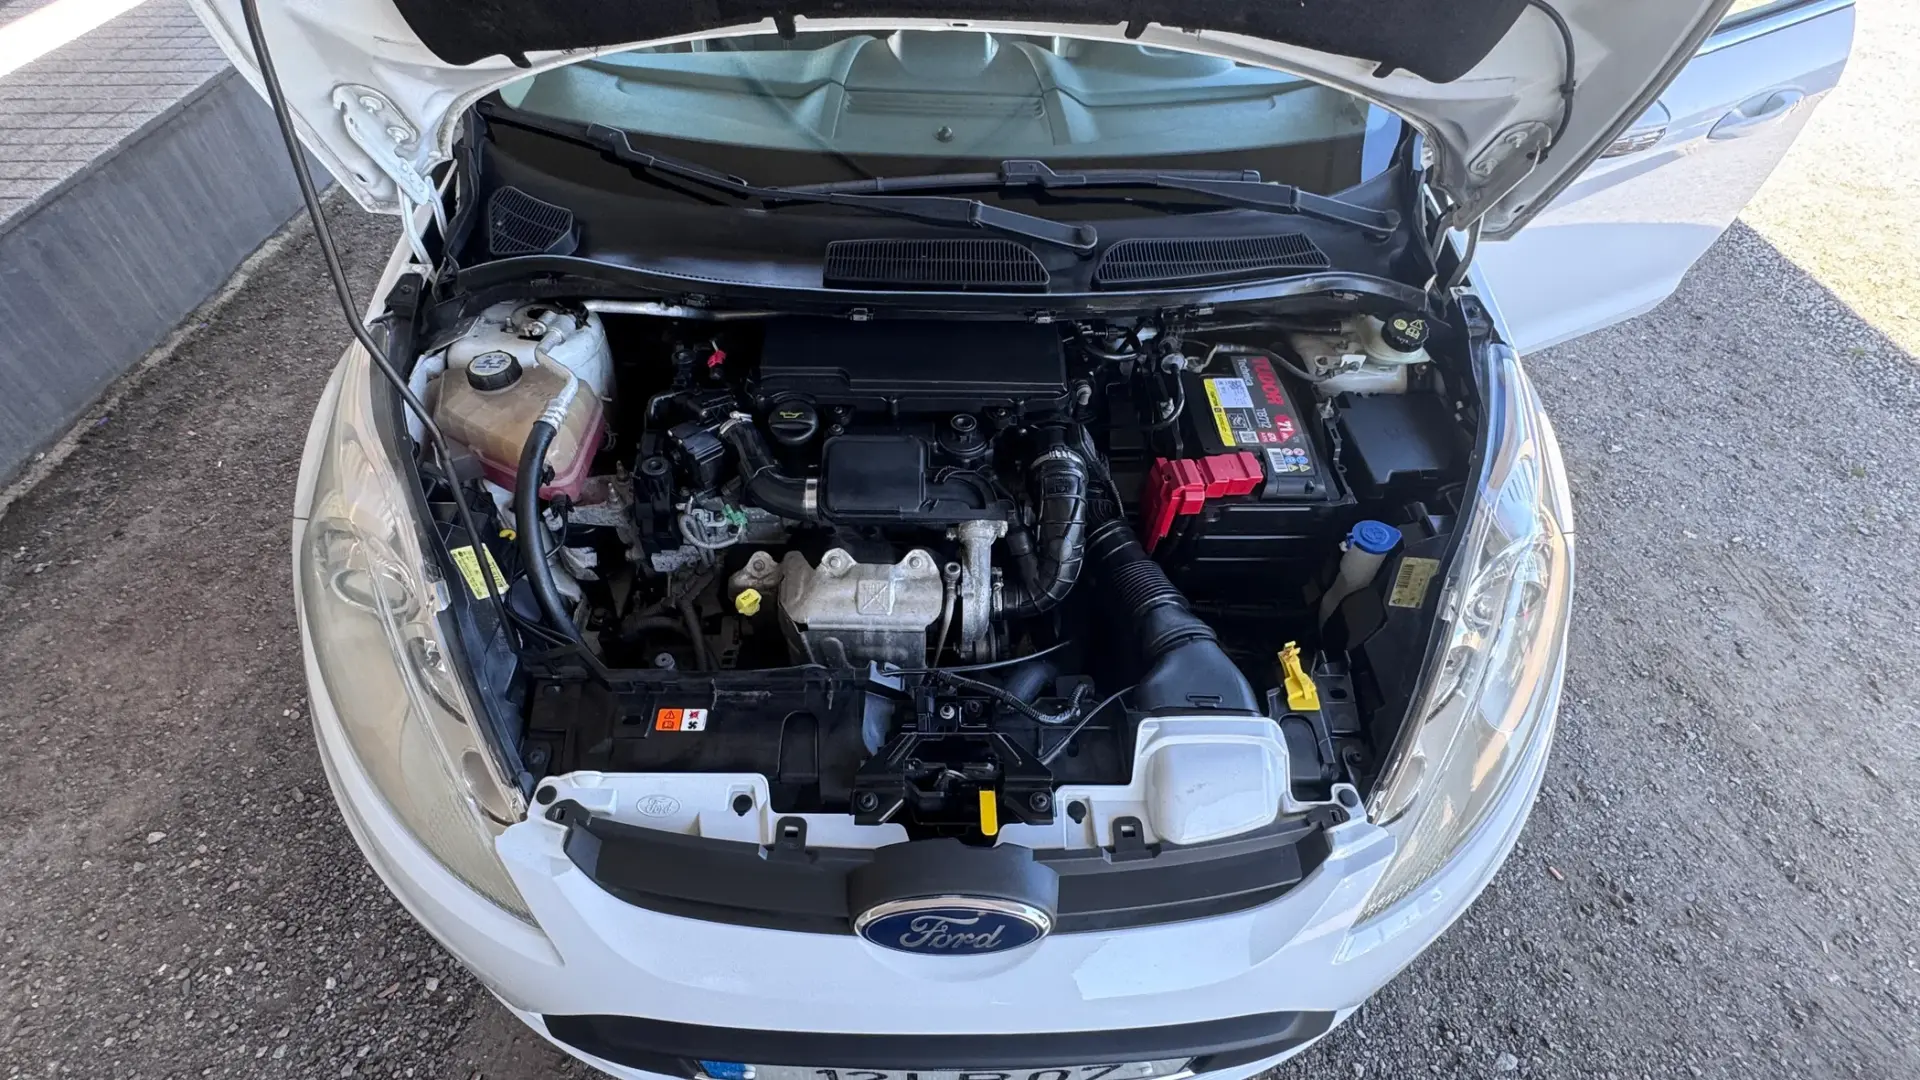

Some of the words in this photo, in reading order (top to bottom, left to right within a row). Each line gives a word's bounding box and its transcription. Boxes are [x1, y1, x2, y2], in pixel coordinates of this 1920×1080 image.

[1252, 357, 1284, 404] TUDOR
[1277, 420, 1294, 432] 71
[645, 797, 673, 815] Ford
[899, 915, 1006, 950] Ford
